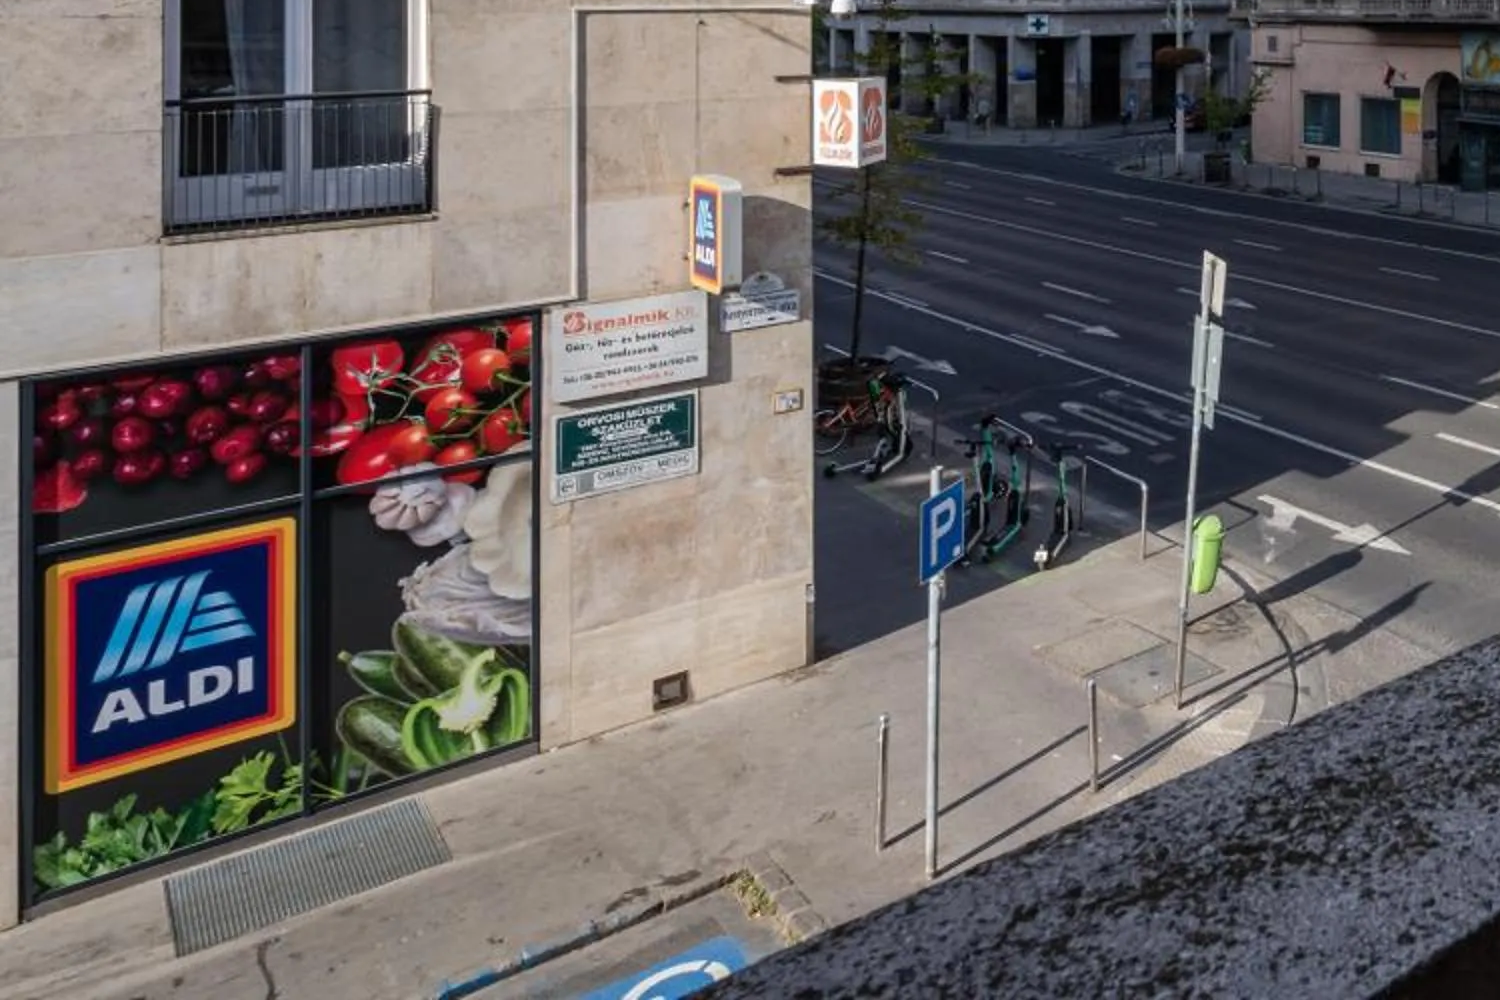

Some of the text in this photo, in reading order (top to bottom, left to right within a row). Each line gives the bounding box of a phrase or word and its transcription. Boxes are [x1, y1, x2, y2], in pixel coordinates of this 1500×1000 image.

[695, 243, 715, 266] ALDI
[930, 498, 956, 567] P
[92, 656, 254, 734] ALDI
